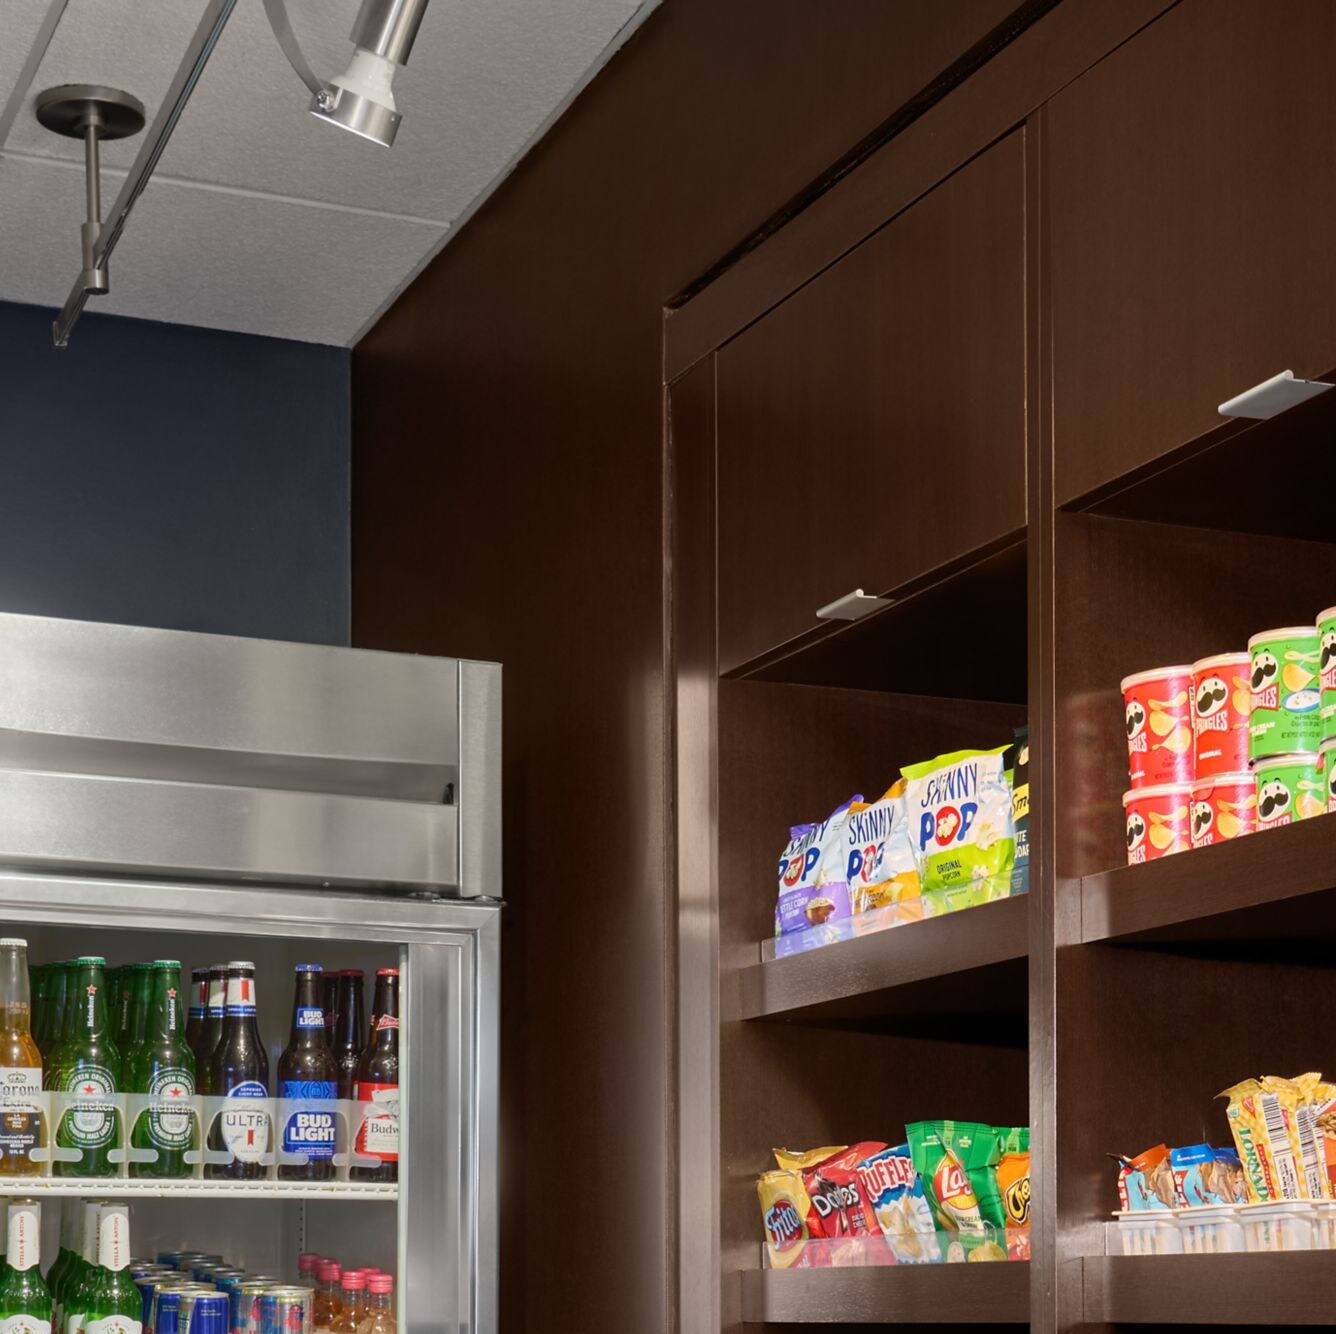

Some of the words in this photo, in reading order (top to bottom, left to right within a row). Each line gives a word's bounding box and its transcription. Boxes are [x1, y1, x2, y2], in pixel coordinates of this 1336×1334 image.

[919, 802, 979, 853] POP
[778, 846, 821, 888] POP
[936, 859, 962, 875] ORIGINAL
[942, 870, 961, 881] POPCORN
[87, 995, 95, 1028] Heineken
[168, 999, 177, 1031] Heineken
[303, 1010, 322, 1018] BUD
[299, 1017, 325, 1026] LIGHT
[0, 1083, 40, 1097] orona
[296, 1114, 332, 1128] BUD
[290, 1127, 336, 1142] LIGHT
[1238, 1128, 1265, 1187] LORNA
